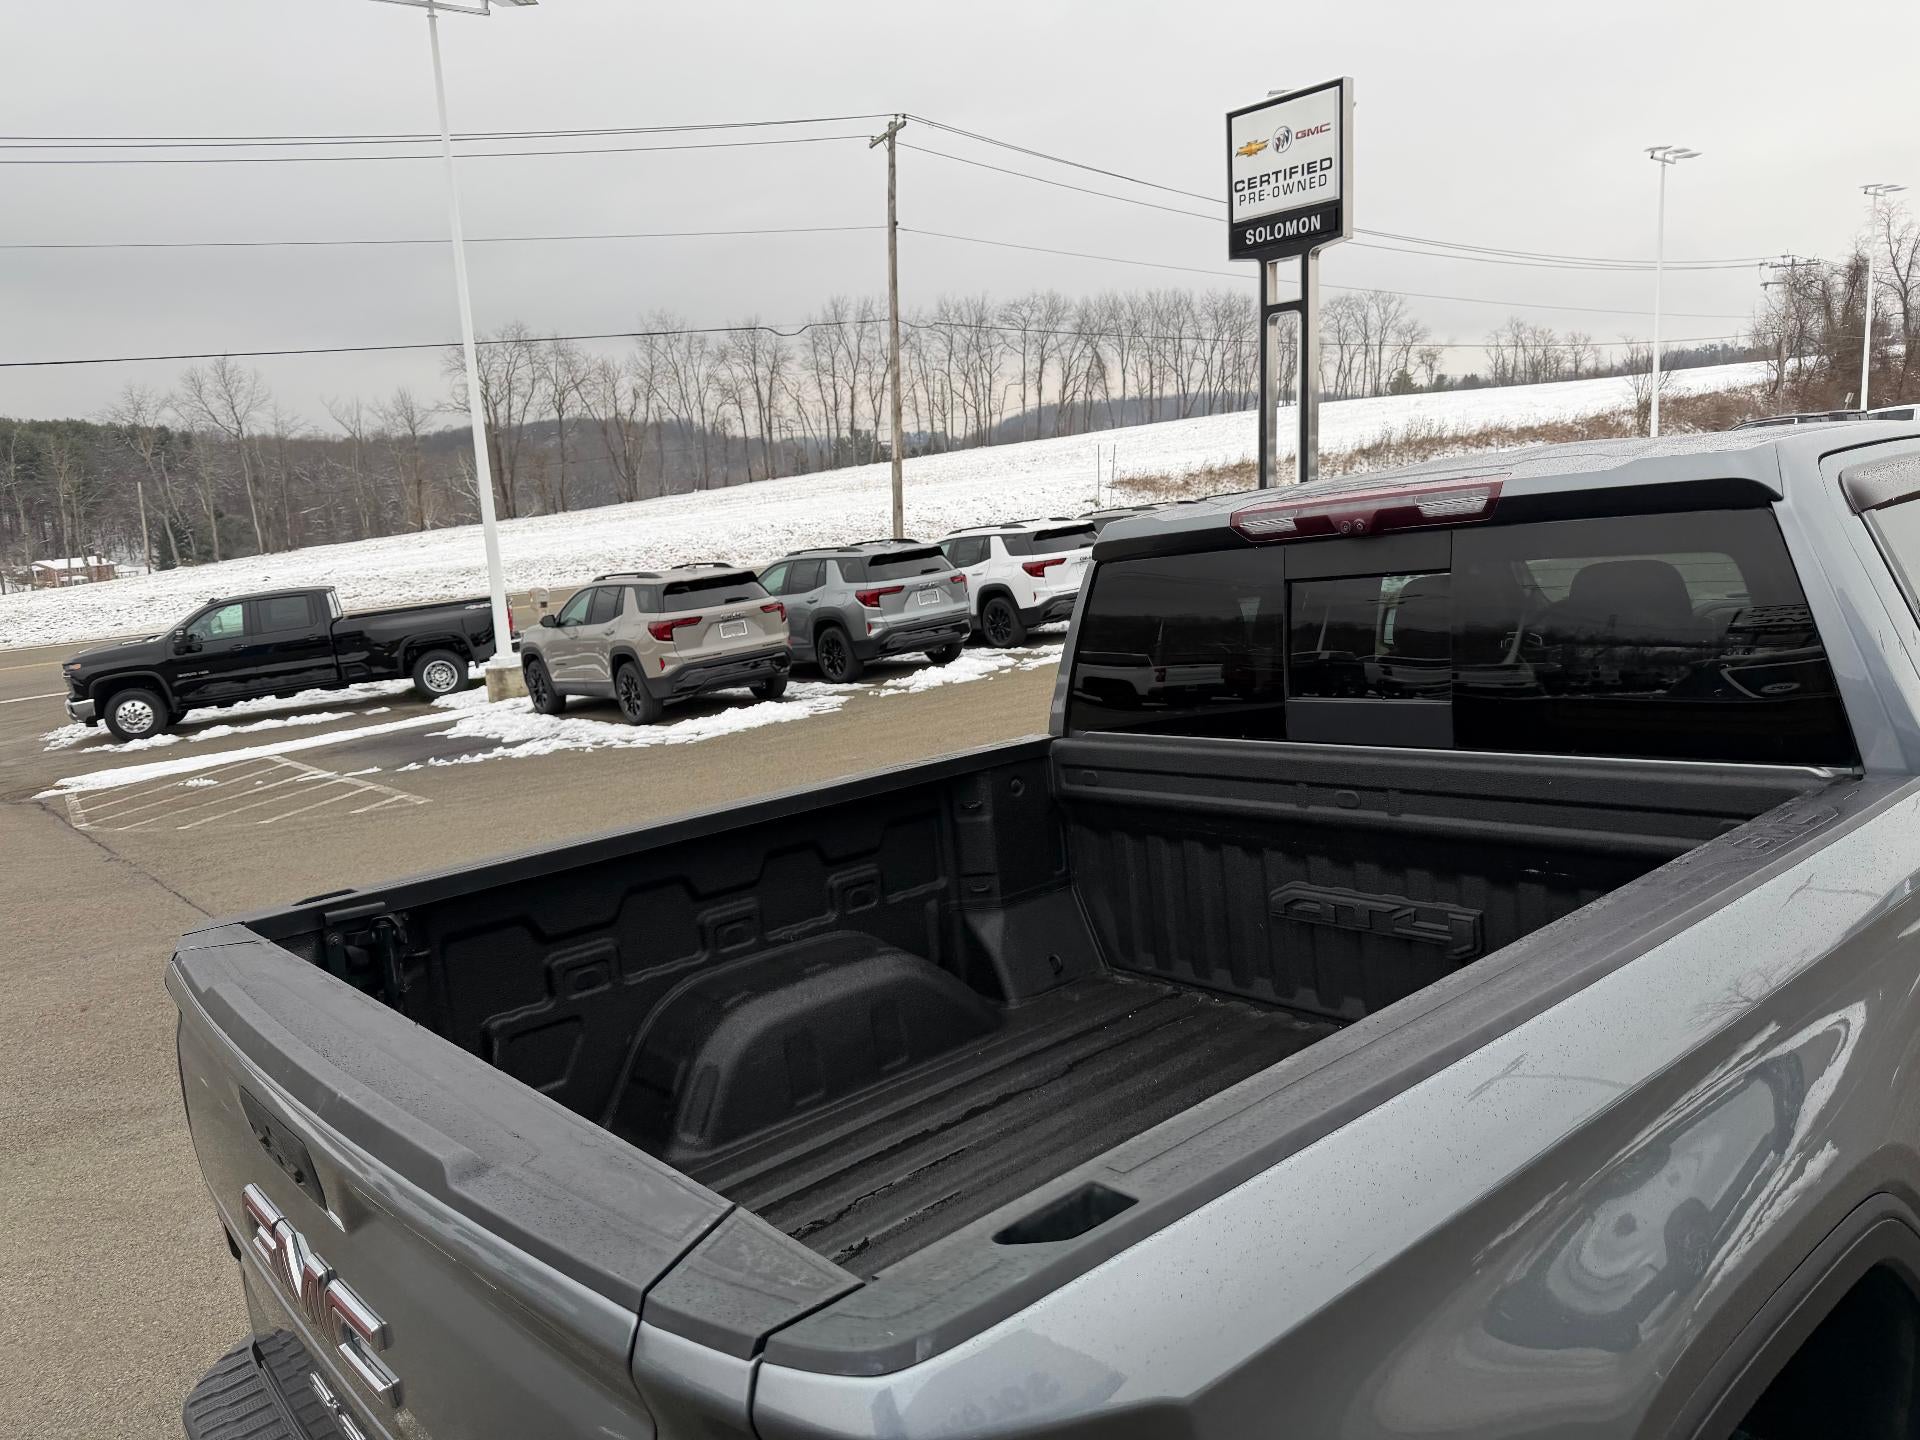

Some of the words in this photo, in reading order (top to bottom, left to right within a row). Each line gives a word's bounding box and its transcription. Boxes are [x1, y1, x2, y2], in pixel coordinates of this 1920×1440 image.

[1295, 123, 1330, 139] GMC
[1234, 157, 1331, 192] CERTIFIED
[1239, 174, 1326, 205] PRE-OWNED
[1245, 214, 1319, 244] SOLOMON
[1269, 884, 1482, 958] AT4
[241, 1182, 401, 1405] GMC
